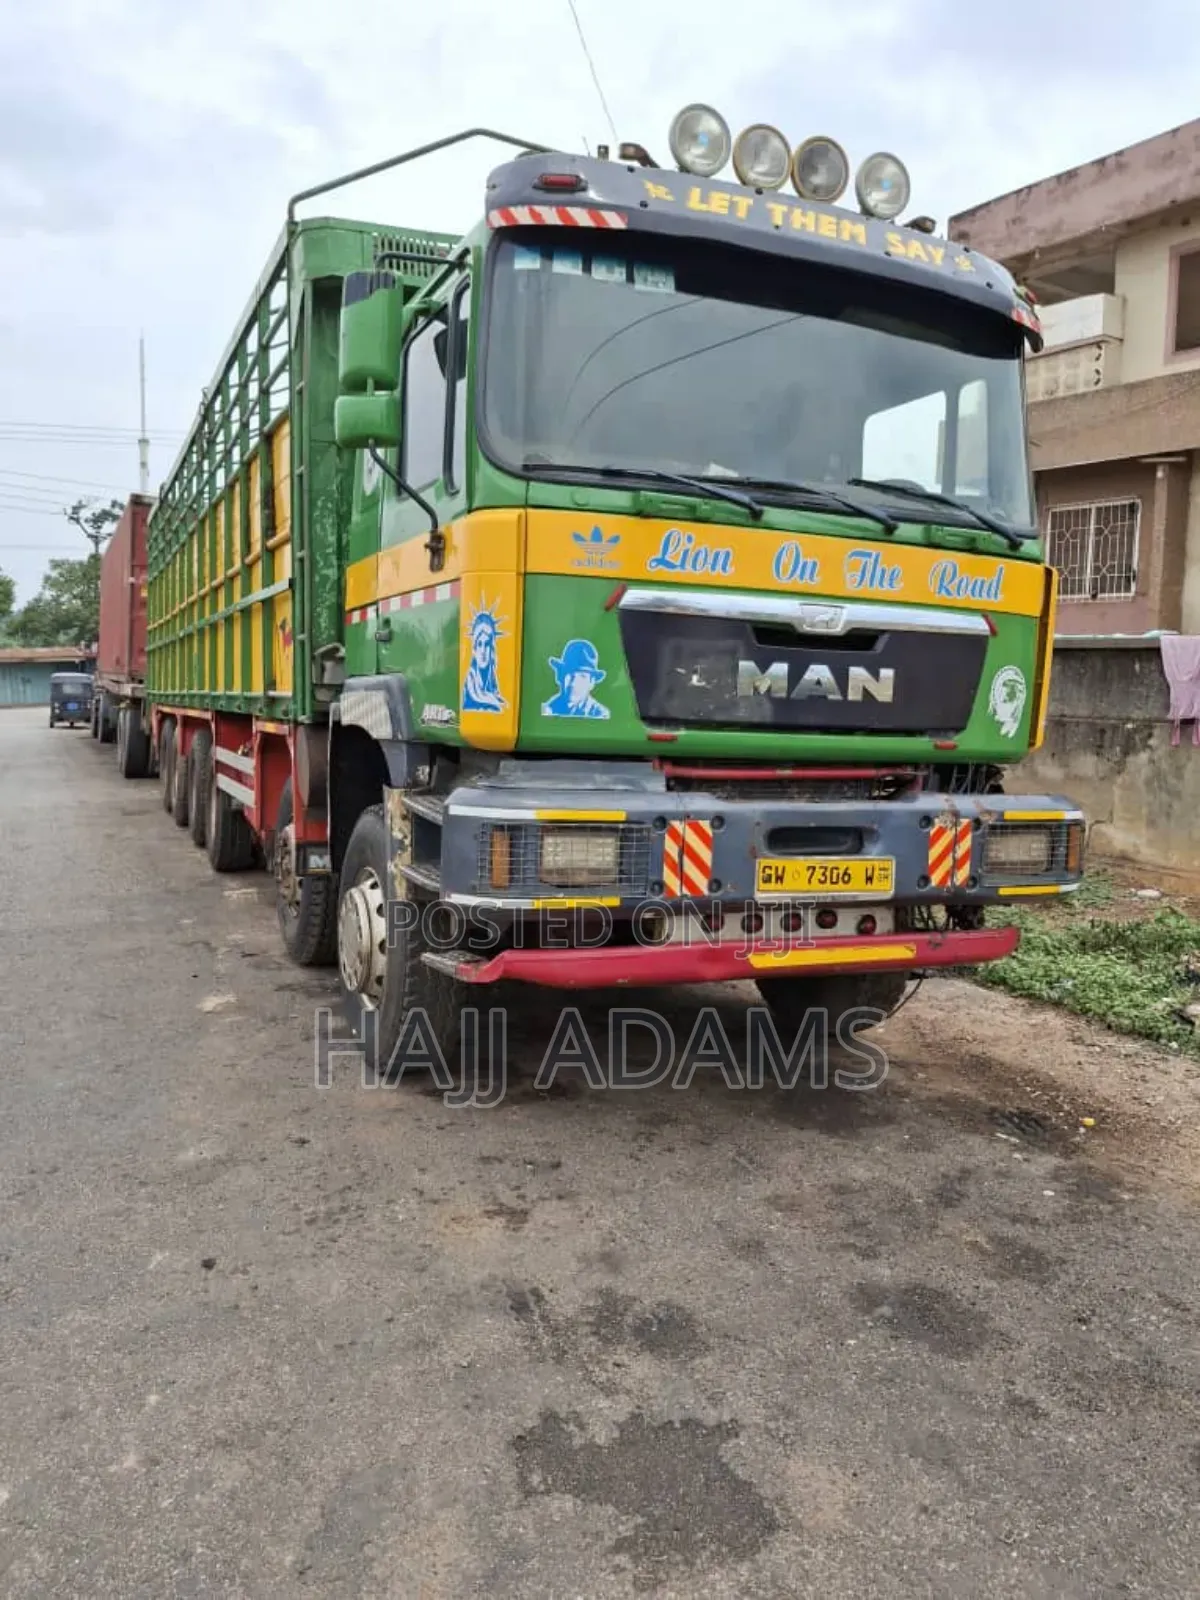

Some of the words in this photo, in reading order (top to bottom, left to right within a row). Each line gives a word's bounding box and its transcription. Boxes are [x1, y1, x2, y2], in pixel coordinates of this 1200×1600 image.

[685, 186, 753, 220] LET
[766, 201, 867, 246] THEM
[884, 230, 945, 267] SAY
[647, 528, 735, 575] Lion
[773, 540, 820, 584] On
[844, 548, 904, 590] The
[928, 559, 1004, 602] Road
[737, 660, 895, 703] MAN
[761, 865, 786, 885] GW
[805, 865, 852, 886] 7306
[864, 865, 876, 886] W
